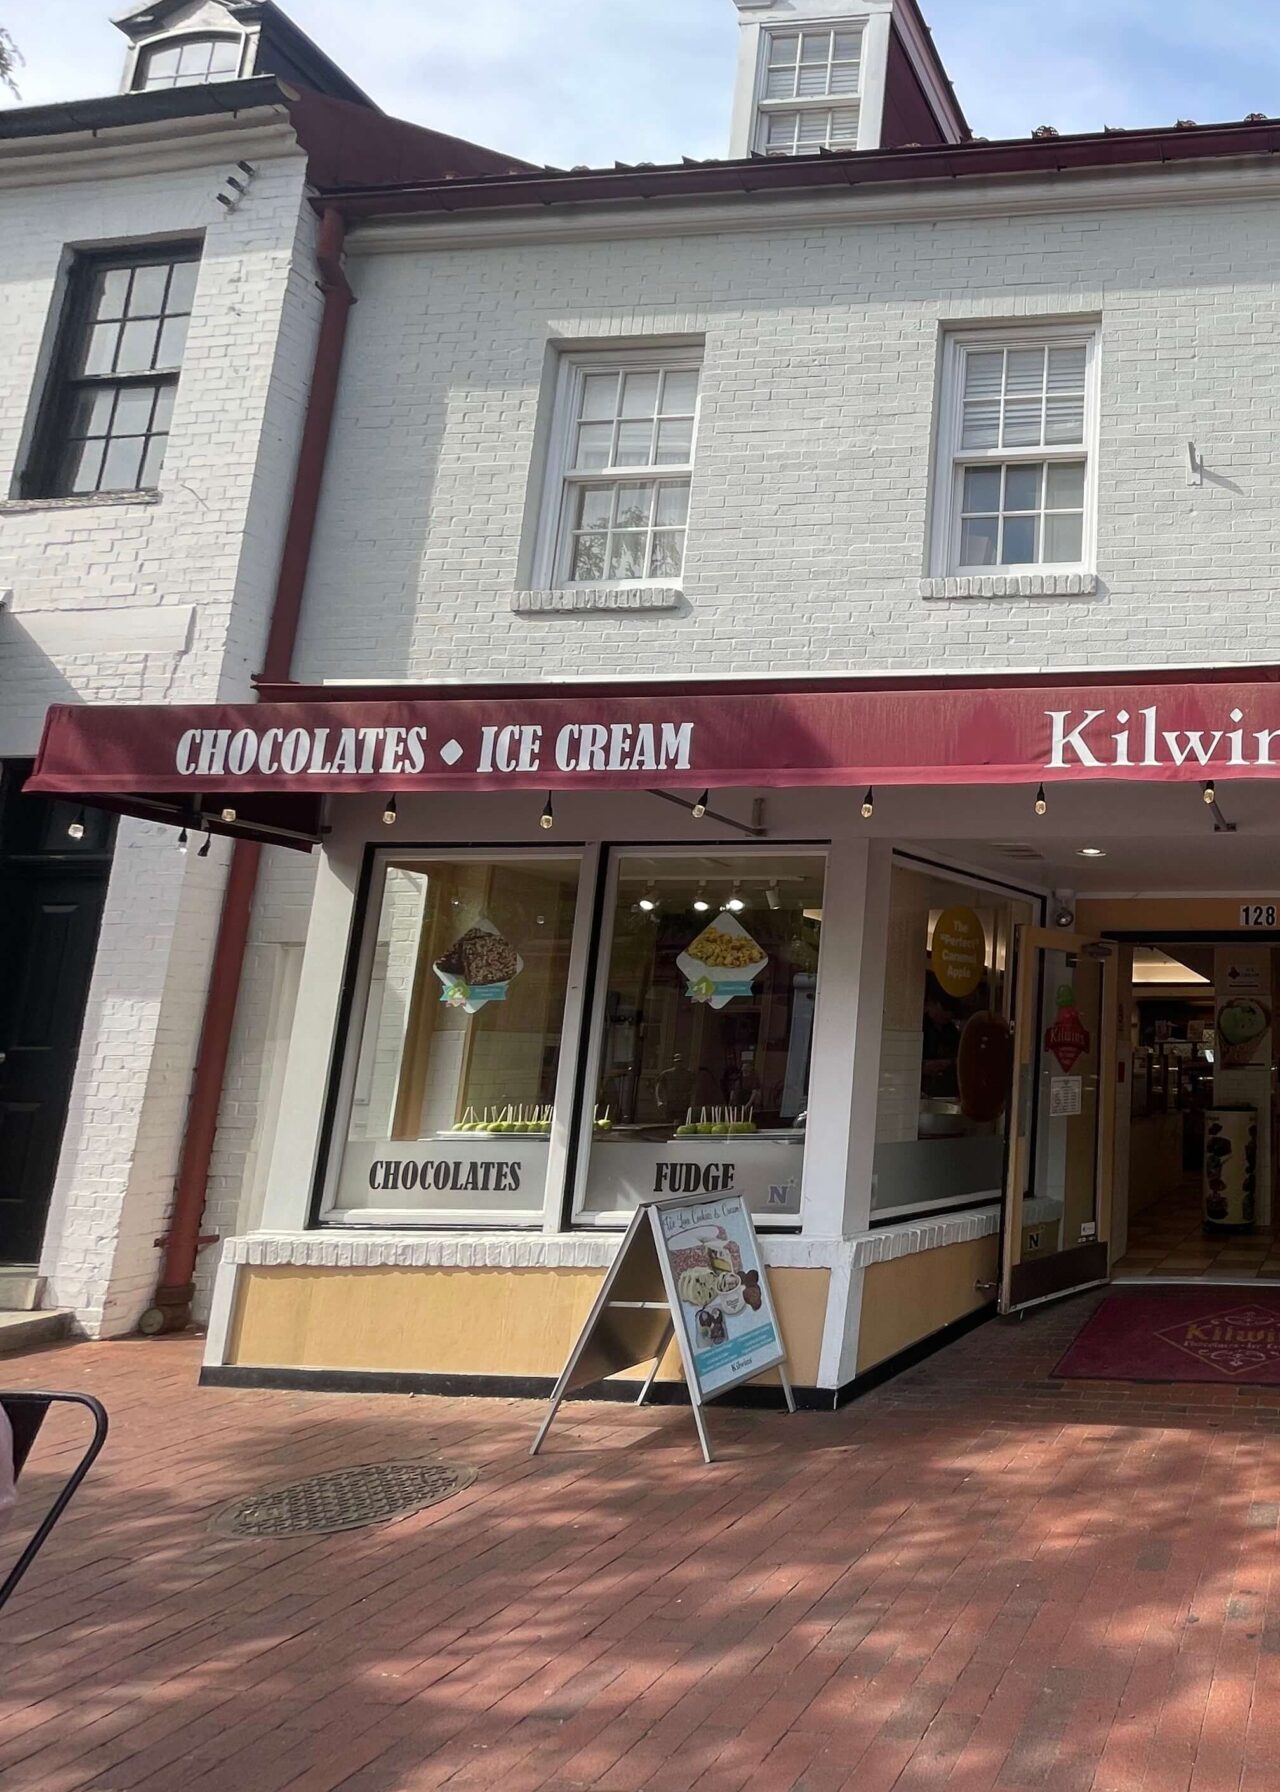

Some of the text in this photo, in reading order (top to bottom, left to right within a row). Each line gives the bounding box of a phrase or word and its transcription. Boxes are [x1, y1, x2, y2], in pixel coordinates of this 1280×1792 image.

[175, 722, 695, 775] CHOCOLATES ICE CREAM
[1242, 906, 1276, 926] 128
[369, 1160, 521, 1191] CHOCOLATES
[653, 1162, 735, 1193] FUDGE
